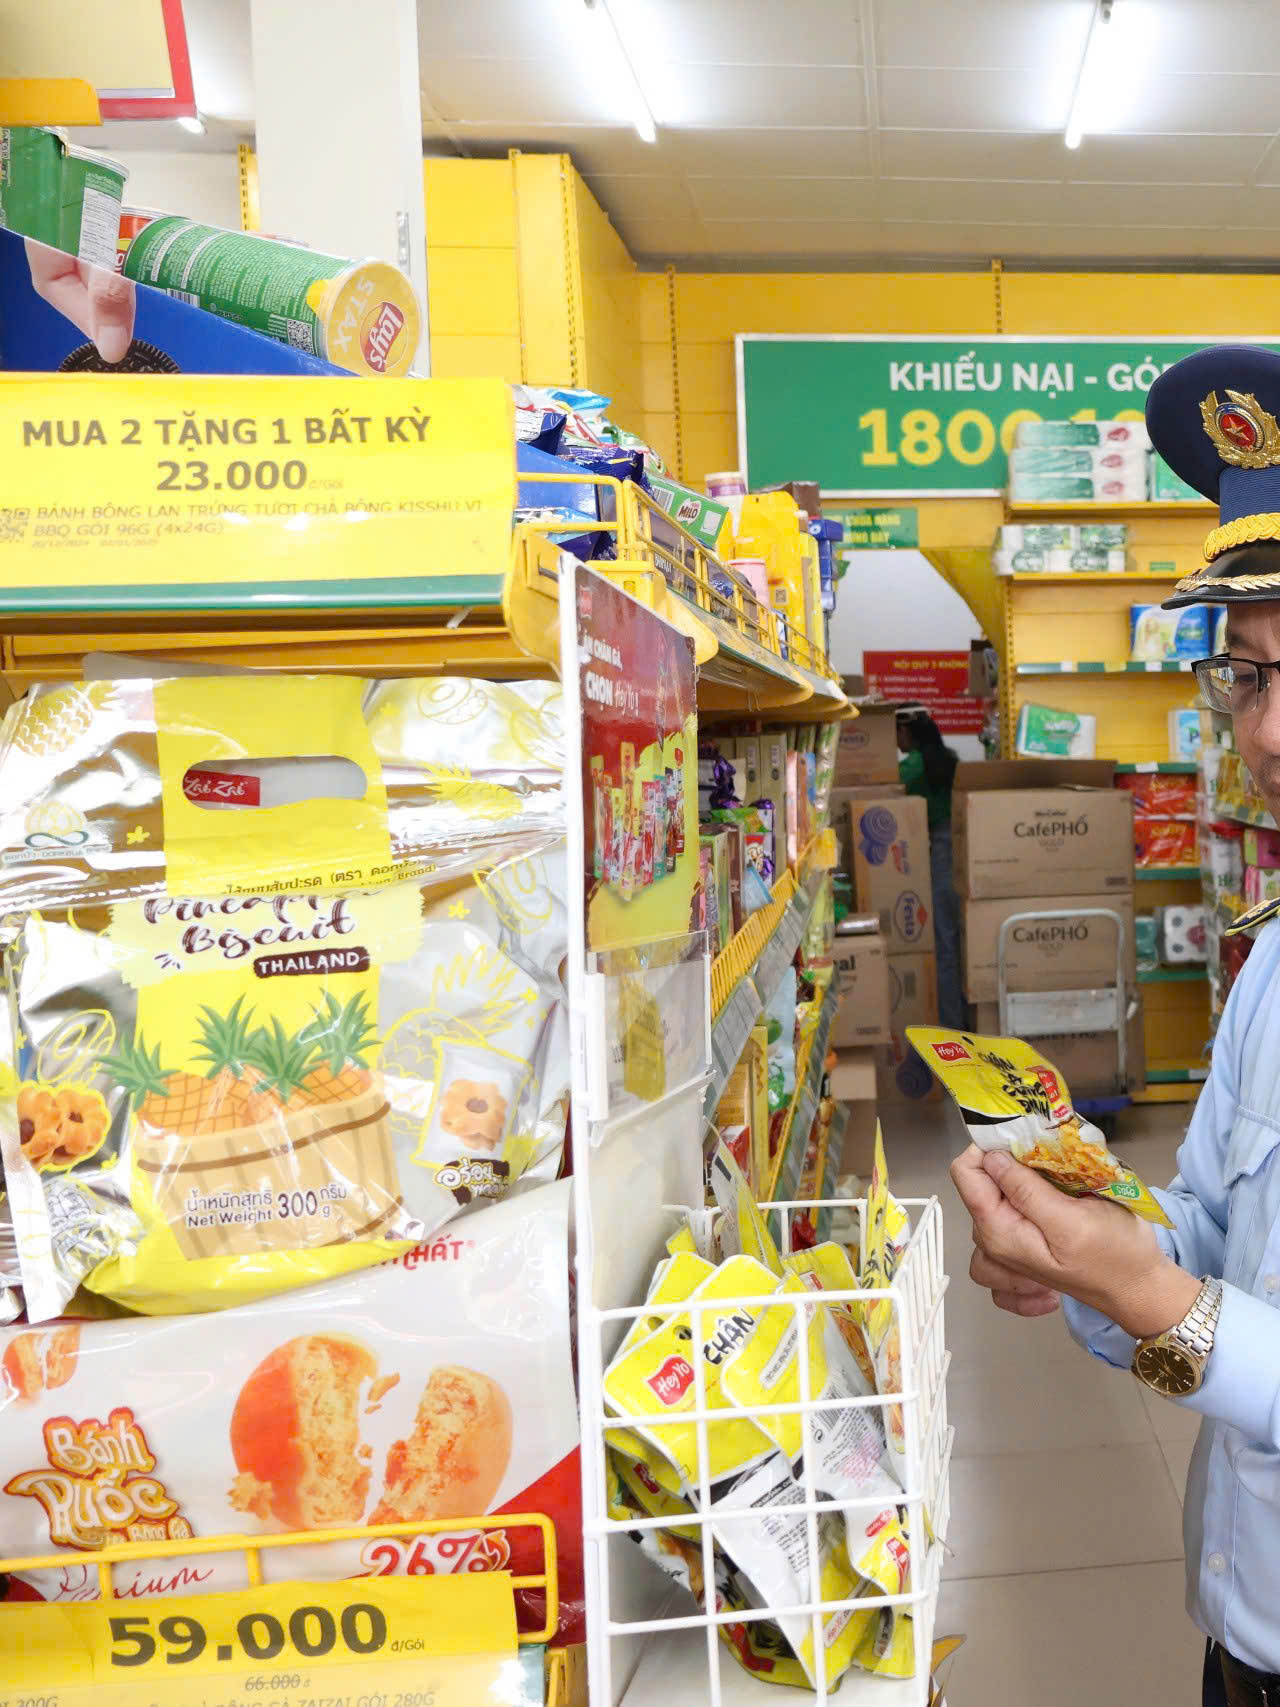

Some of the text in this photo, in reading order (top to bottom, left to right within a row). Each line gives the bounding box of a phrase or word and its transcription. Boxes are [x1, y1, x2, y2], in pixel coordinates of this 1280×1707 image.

[889, 350, 1003, 392] KHIẾU
[1012, 361, 1075, 400] NẠI
[22, 406, 433, 452] MUA 2 TẶNG 1 BẤT KỲ
[155, 460, 308, 492] 23.000
[678, 504, 699, 520] MILO
[212, 779, 246, 798] Zai
[1013, 814, 1089, 839] CaféPHỐ
[258, 950, 361, 975] THAILAND
[186, 1187, 273, 1213] น้ำหนักสุทธิ
[277, 1191, 318, 1220] 300
[186, 1212, 216, 1229] Net
[219, 1208, 273, 1227] Weight
[703, 1307, 757, 1366] CHÂN
[655, 1362, 692, 1398] Hey Yo
[50, 1416, 150, 1474] Bánh
[370, 1536, 491, 1577] 26%
[108, 1603, 426, 1667] 59.000 đ/Gói
[244, 1674, 300, 1691] 66.000
[394, 1690, 436, 1706] 280G
